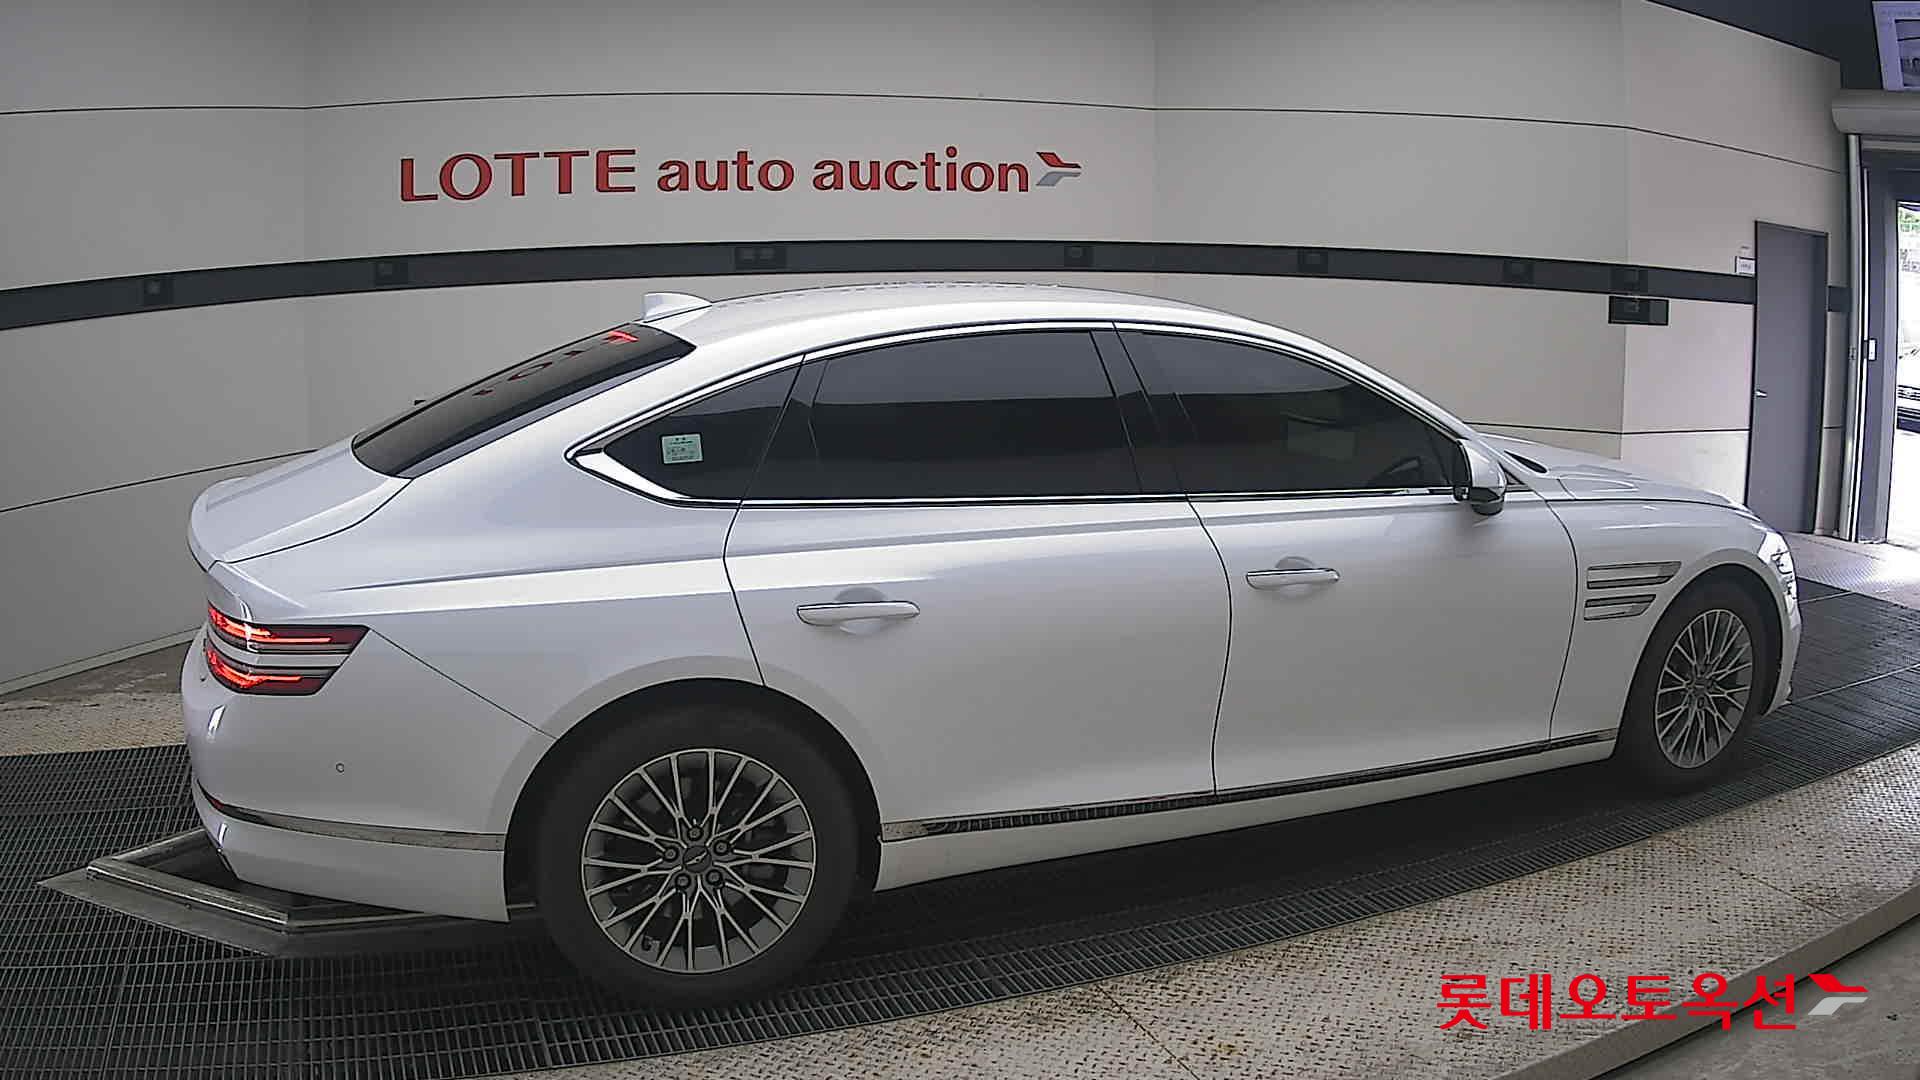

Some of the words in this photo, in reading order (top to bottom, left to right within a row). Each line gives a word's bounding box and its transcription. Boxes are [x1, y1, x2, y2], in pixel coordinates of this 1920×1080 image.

[400, 149, 637, 202] LOTTE
[656, 150, 796, 193] auto
[813, 146, 1031, 193] auction
